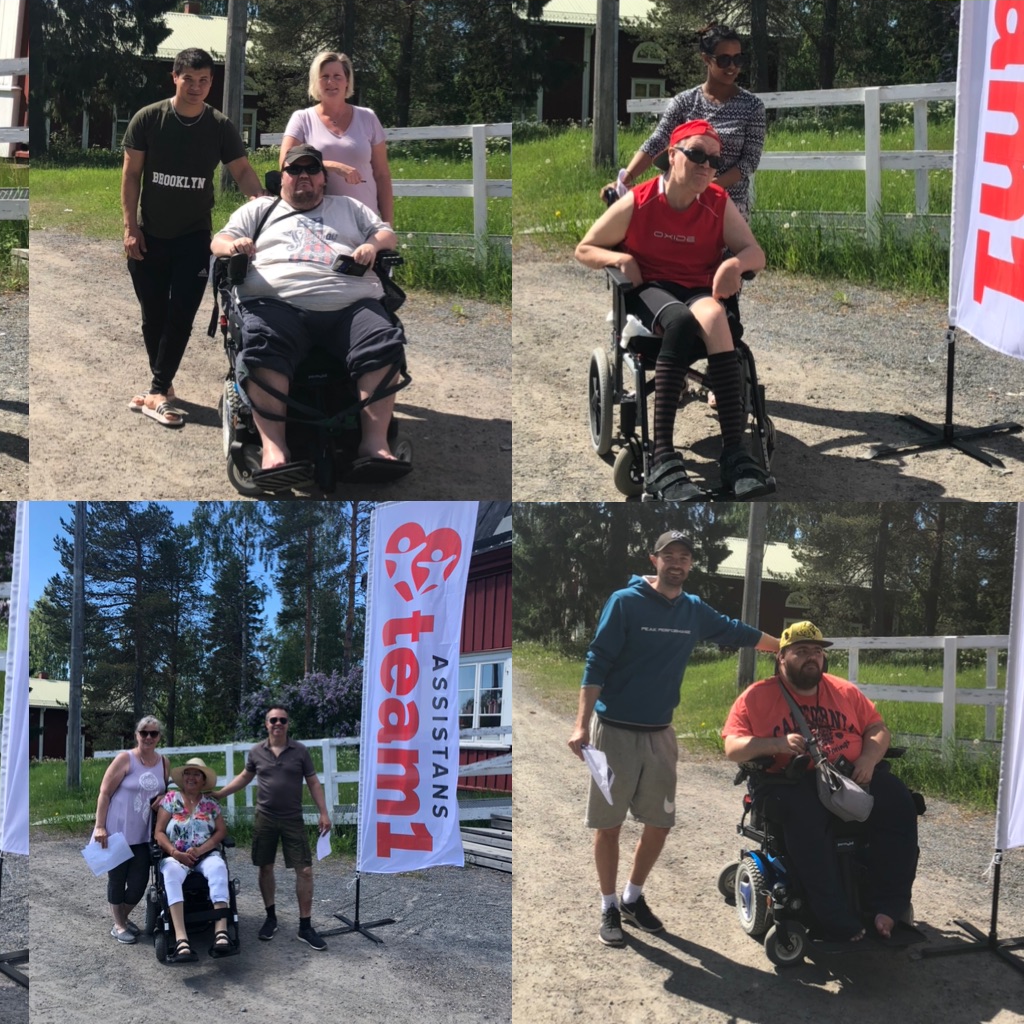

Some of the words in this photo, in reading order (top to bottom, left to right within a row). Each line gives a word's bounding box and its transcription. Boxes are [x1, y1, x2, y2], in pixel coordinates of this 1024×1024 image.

[152, 171, 206, 189] BROOKLYN
[653, 230, 696, 243] OXIDE
[376, 609, 435, 858] team1
[431, 654, 449, 819] ASSISTANS
